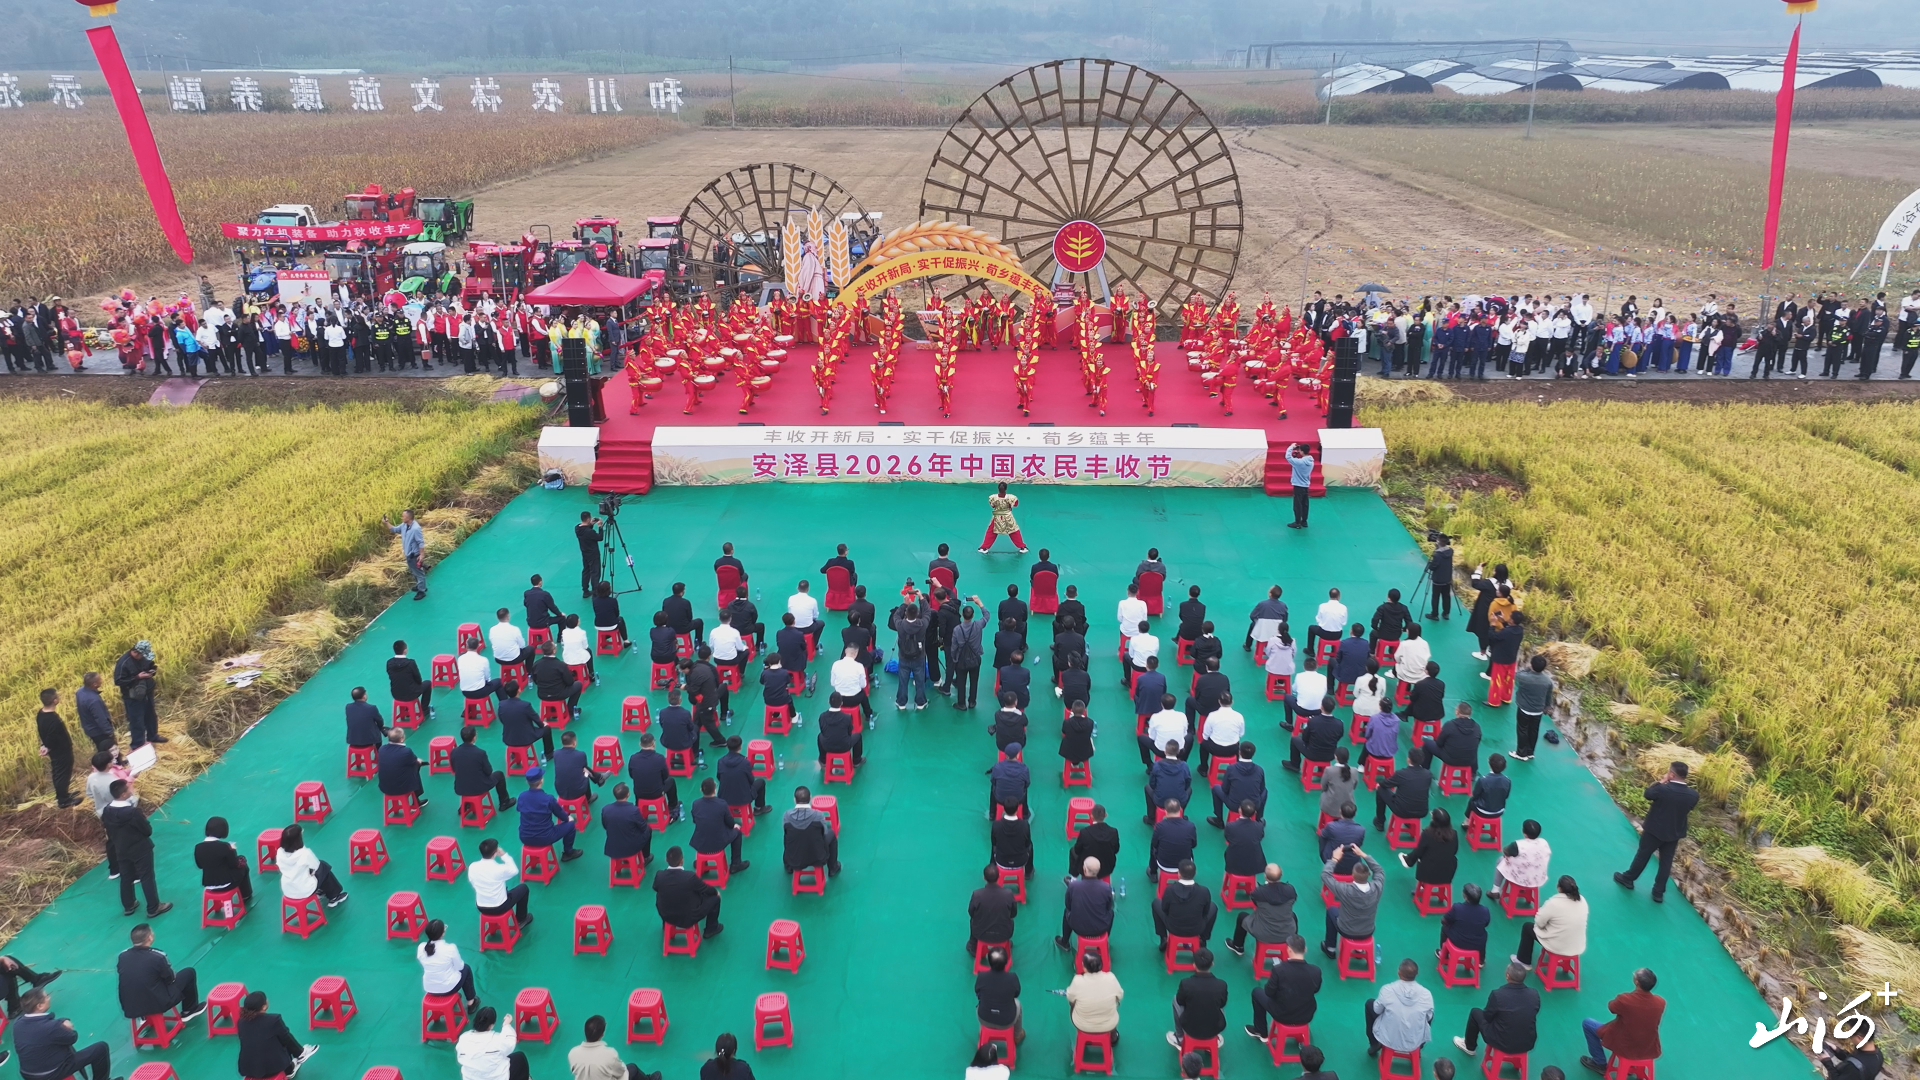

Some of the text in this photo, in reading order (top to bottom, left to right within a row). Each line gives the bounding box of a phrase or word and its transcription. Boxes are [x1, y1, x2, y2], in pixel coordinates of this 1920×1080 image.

[237, 223, 410, 239] 聚力农机装备 助力秋收丰产
[763, 430, 1156, 445] 丰收开新局·实干促振兴·荀乡蕴丰年
[752, 452, 1172, 479] 安泽县2026年中国农民丰收节
